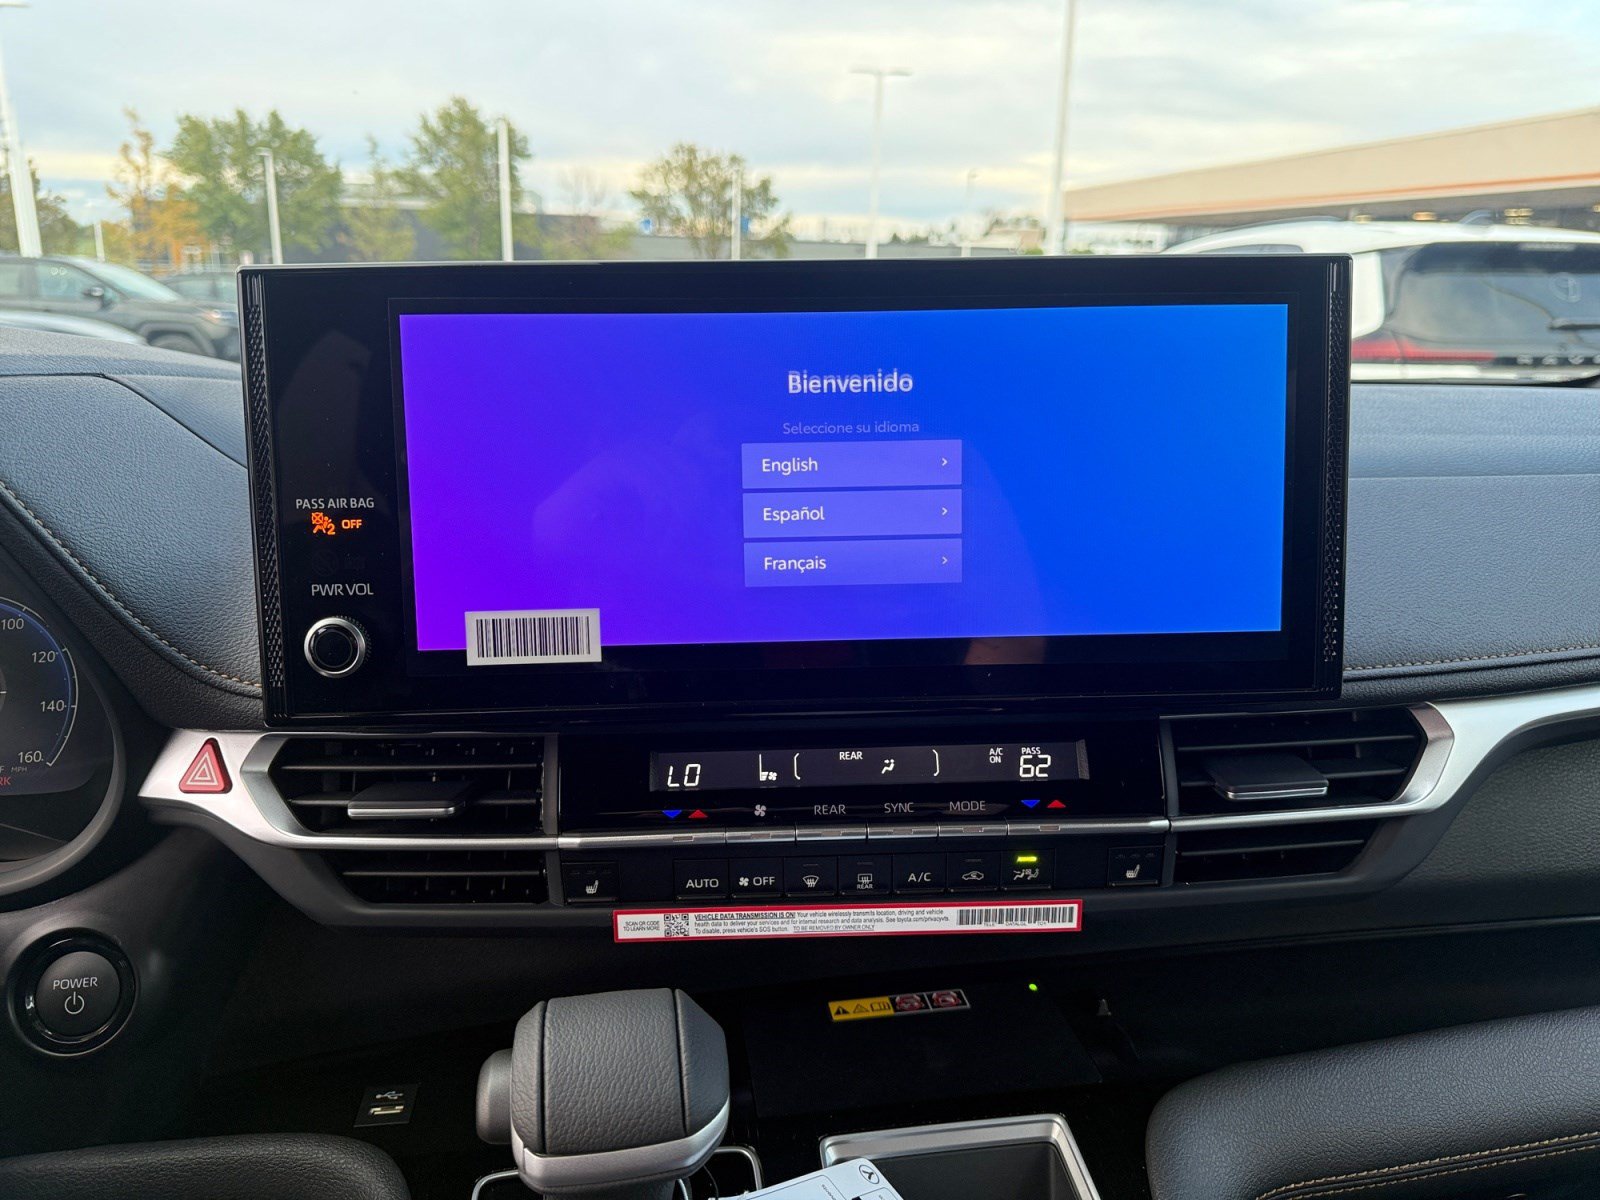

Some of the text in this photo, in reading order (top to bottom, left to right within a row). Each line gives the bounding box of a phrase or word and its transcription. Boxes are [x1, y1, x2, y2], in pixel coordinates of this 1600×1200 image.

[788, 369, 913, 394] Bienvenido
[783, 421, 920, 435] Seleccione su idioma
[762, 457, 818, 476] English
[296, 498, 374, 510] PASS AIR BAG
[763, 506, 825, 524] Español
[342, 519, 362, 529] OFF
[764, 556, 827, 573] Français
[311, 584, 374, 596] PWR VOL
[1, 618, 24, 630] 100
[31, 651, 56, 663] 120
[40, 700, 65, 712] 140
[18, 750, 42, 763] 160
[839, 751, 863, 760] REAR
[1019, 754, 1052, 778] 62
[667, 764, 701, 787] LO
[814, 804, 846, 815] REAR
[884, 802, 914, 814] SYNC
[950, 800, 986, 812] MODE
[686, 878, 719, 888] AUTO
[752, 876, 776, 886] OFF
[908, 872, 932, 882] A/C
[53, 976, 98, 990] POWER
